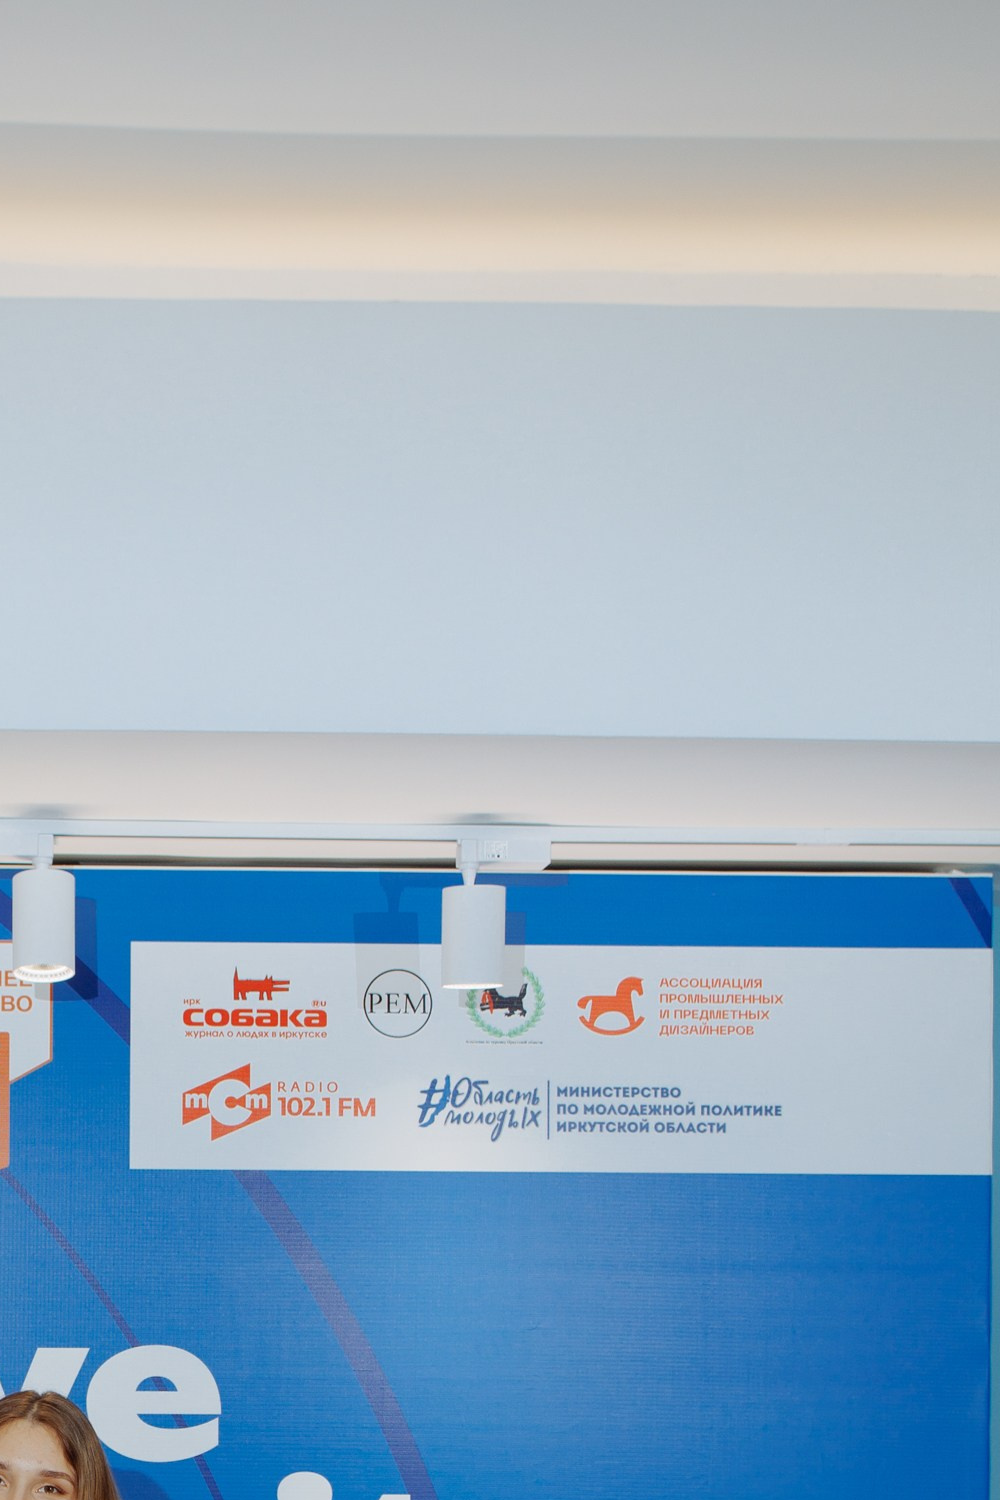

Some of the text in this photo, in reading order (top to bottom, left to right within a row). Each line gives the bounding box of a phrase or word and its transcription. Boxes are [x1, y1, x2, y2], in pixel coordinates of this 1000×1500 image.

[659, 977, 763, 990] АССОЦИАЦИЯ
[659, 993, 784, 1005] ПРОМЫШЛЕННЫХ
[659, 1009, 770, 1021] И ПРЕДМЕТНЫХ
[184, 1030, 224, 1040] журнал
[226, 1030, 234, 1038] о
[235, 1030, 269, 1039] людях
[278, 1031, 328, 1040] иркутске
[658, 1022, 755, 1036] ДИЗАЙНЕРОВ
[277, 1081, 339, 1093] RADIO
[556, 1086, 682, 1099] МИНИСТЕРСТВО
[277, 1097, 376, 1117] 102.1 FM
[556, 1102, 783, 1117] ПО МОЛОДЕЖНОЙ ПОЛИТИКЕ
[444, 1106, 542, 1142] молодых
[556, 1119, 727, 1134] ИРКУТСКОЙ ОБЛАСТИ
